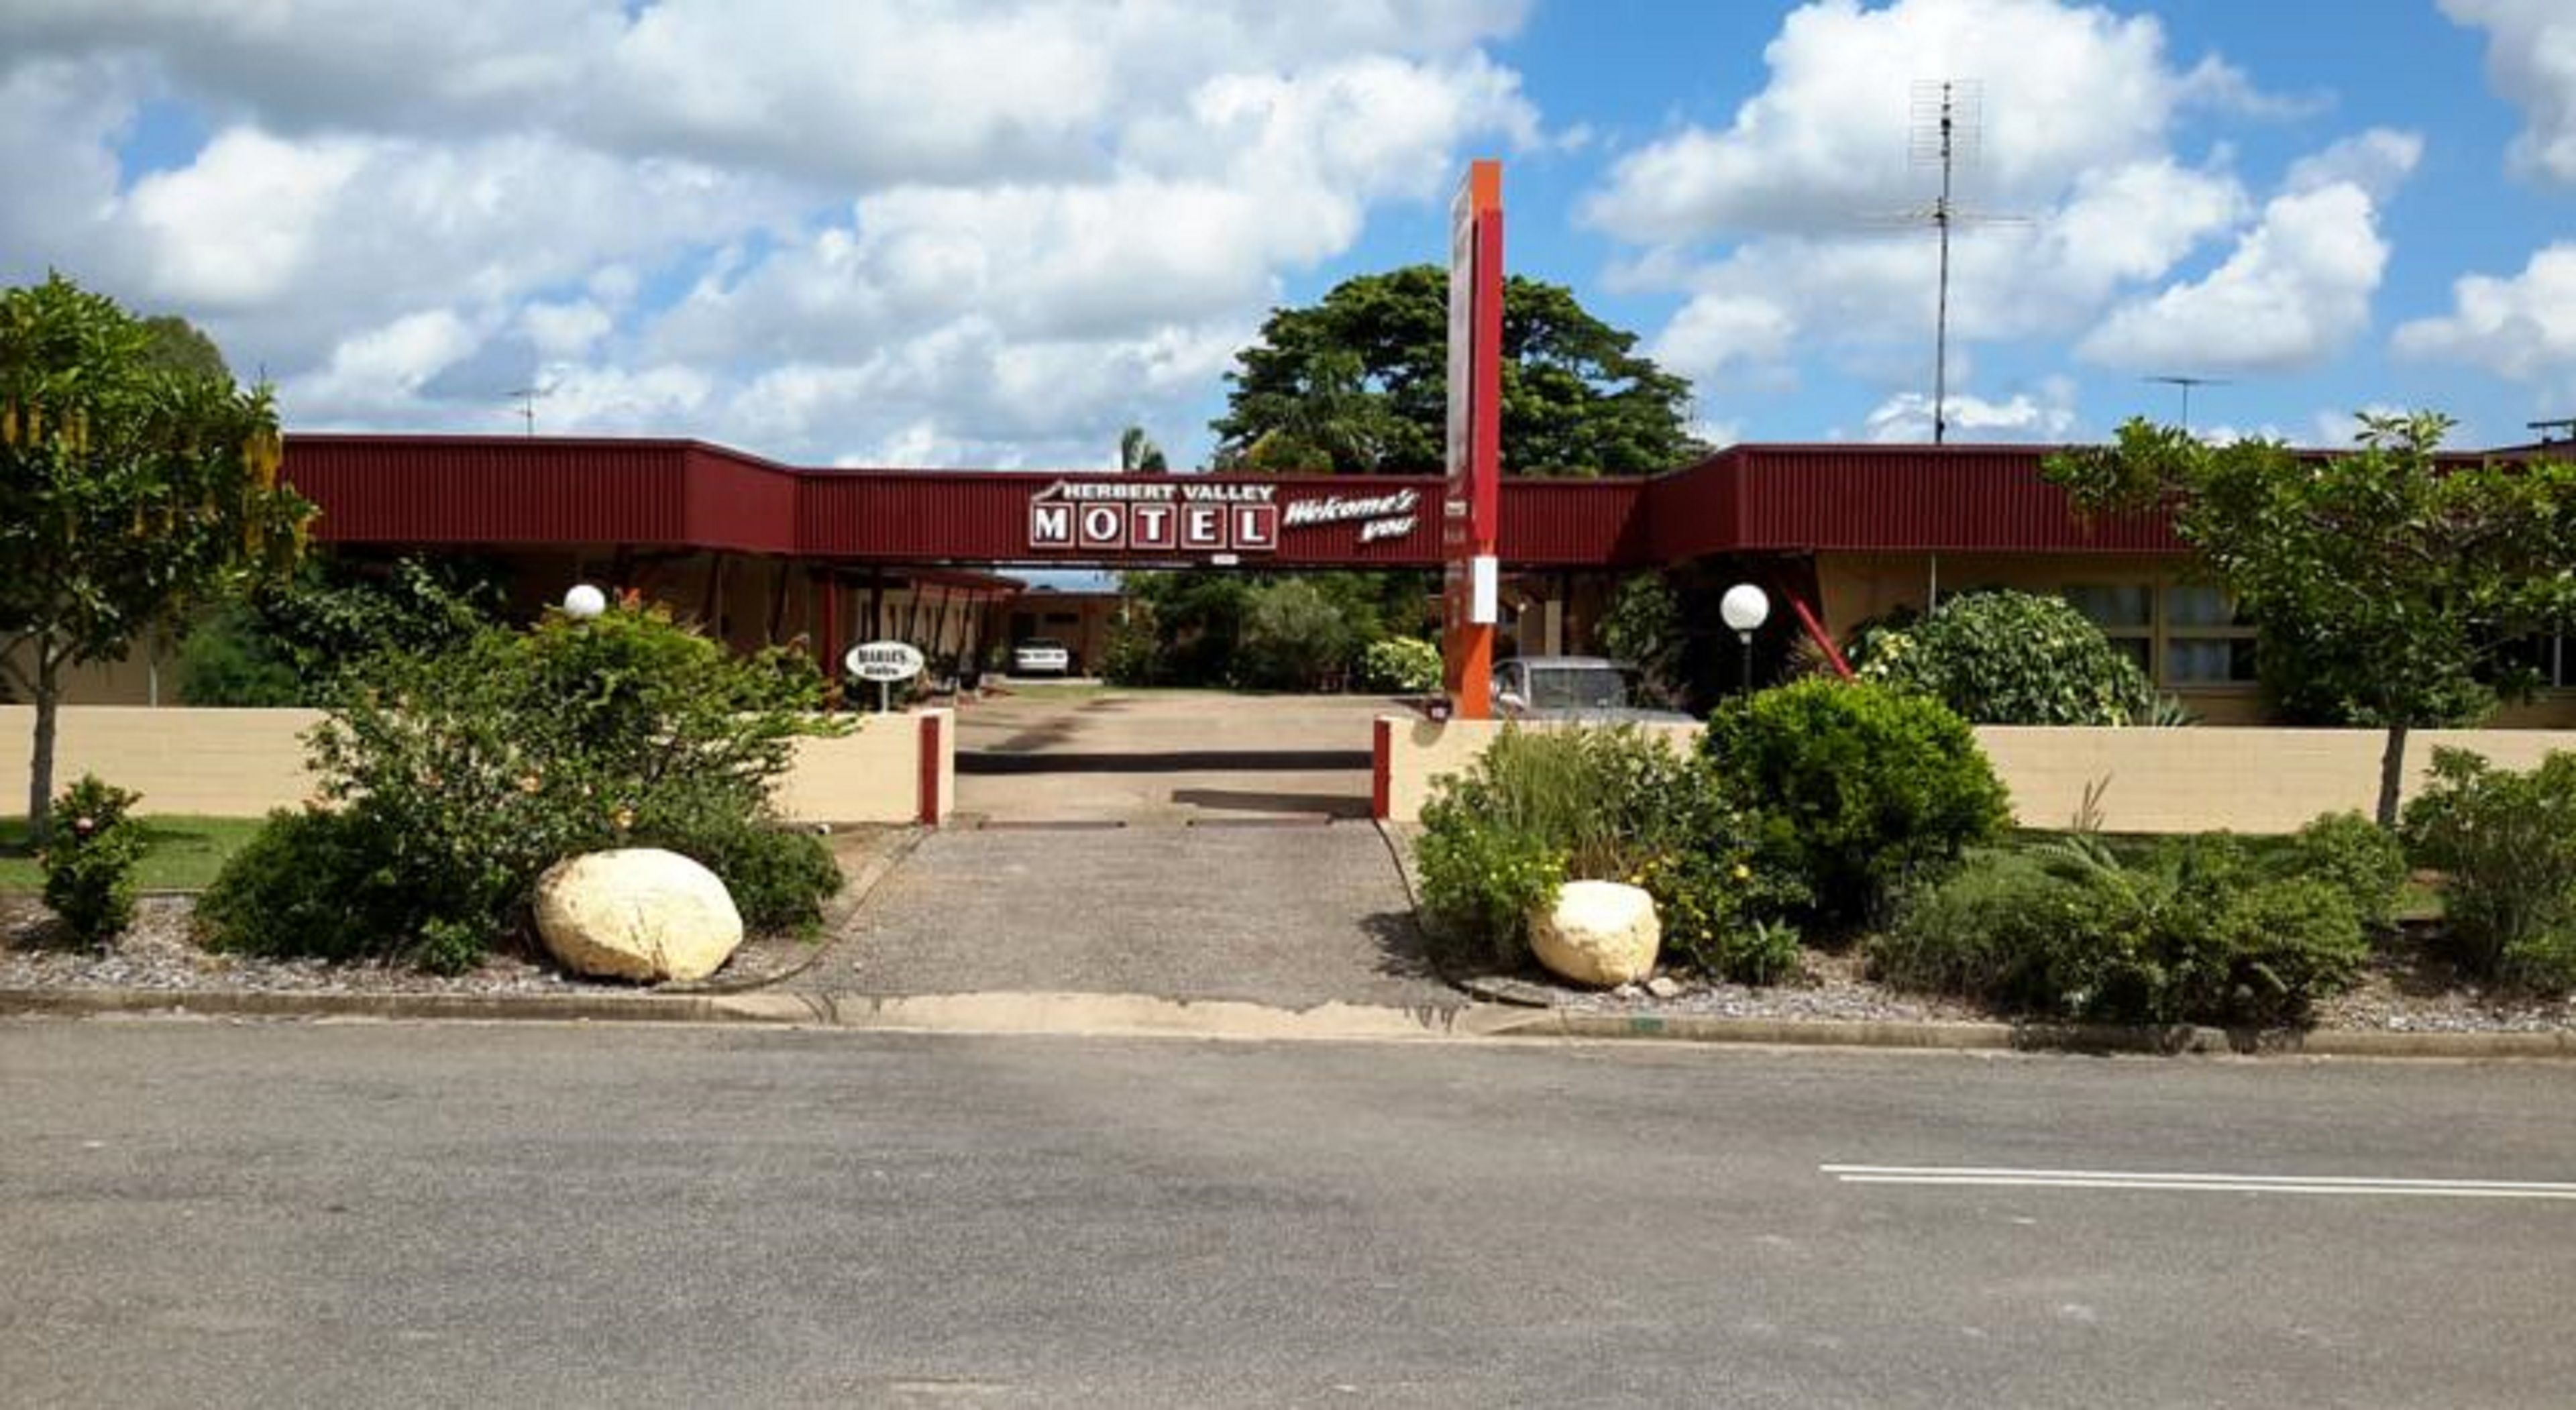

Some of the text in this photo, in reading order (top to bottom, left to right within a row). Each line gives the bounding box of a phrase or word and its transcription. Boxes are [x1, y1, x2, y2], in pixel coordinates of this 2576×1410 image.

[1063, 484, 1275, 500] HERBERT VALLEY
[1035, 507, 1266, 541] MOTEL
[1360, 514, 1419, 542] you
